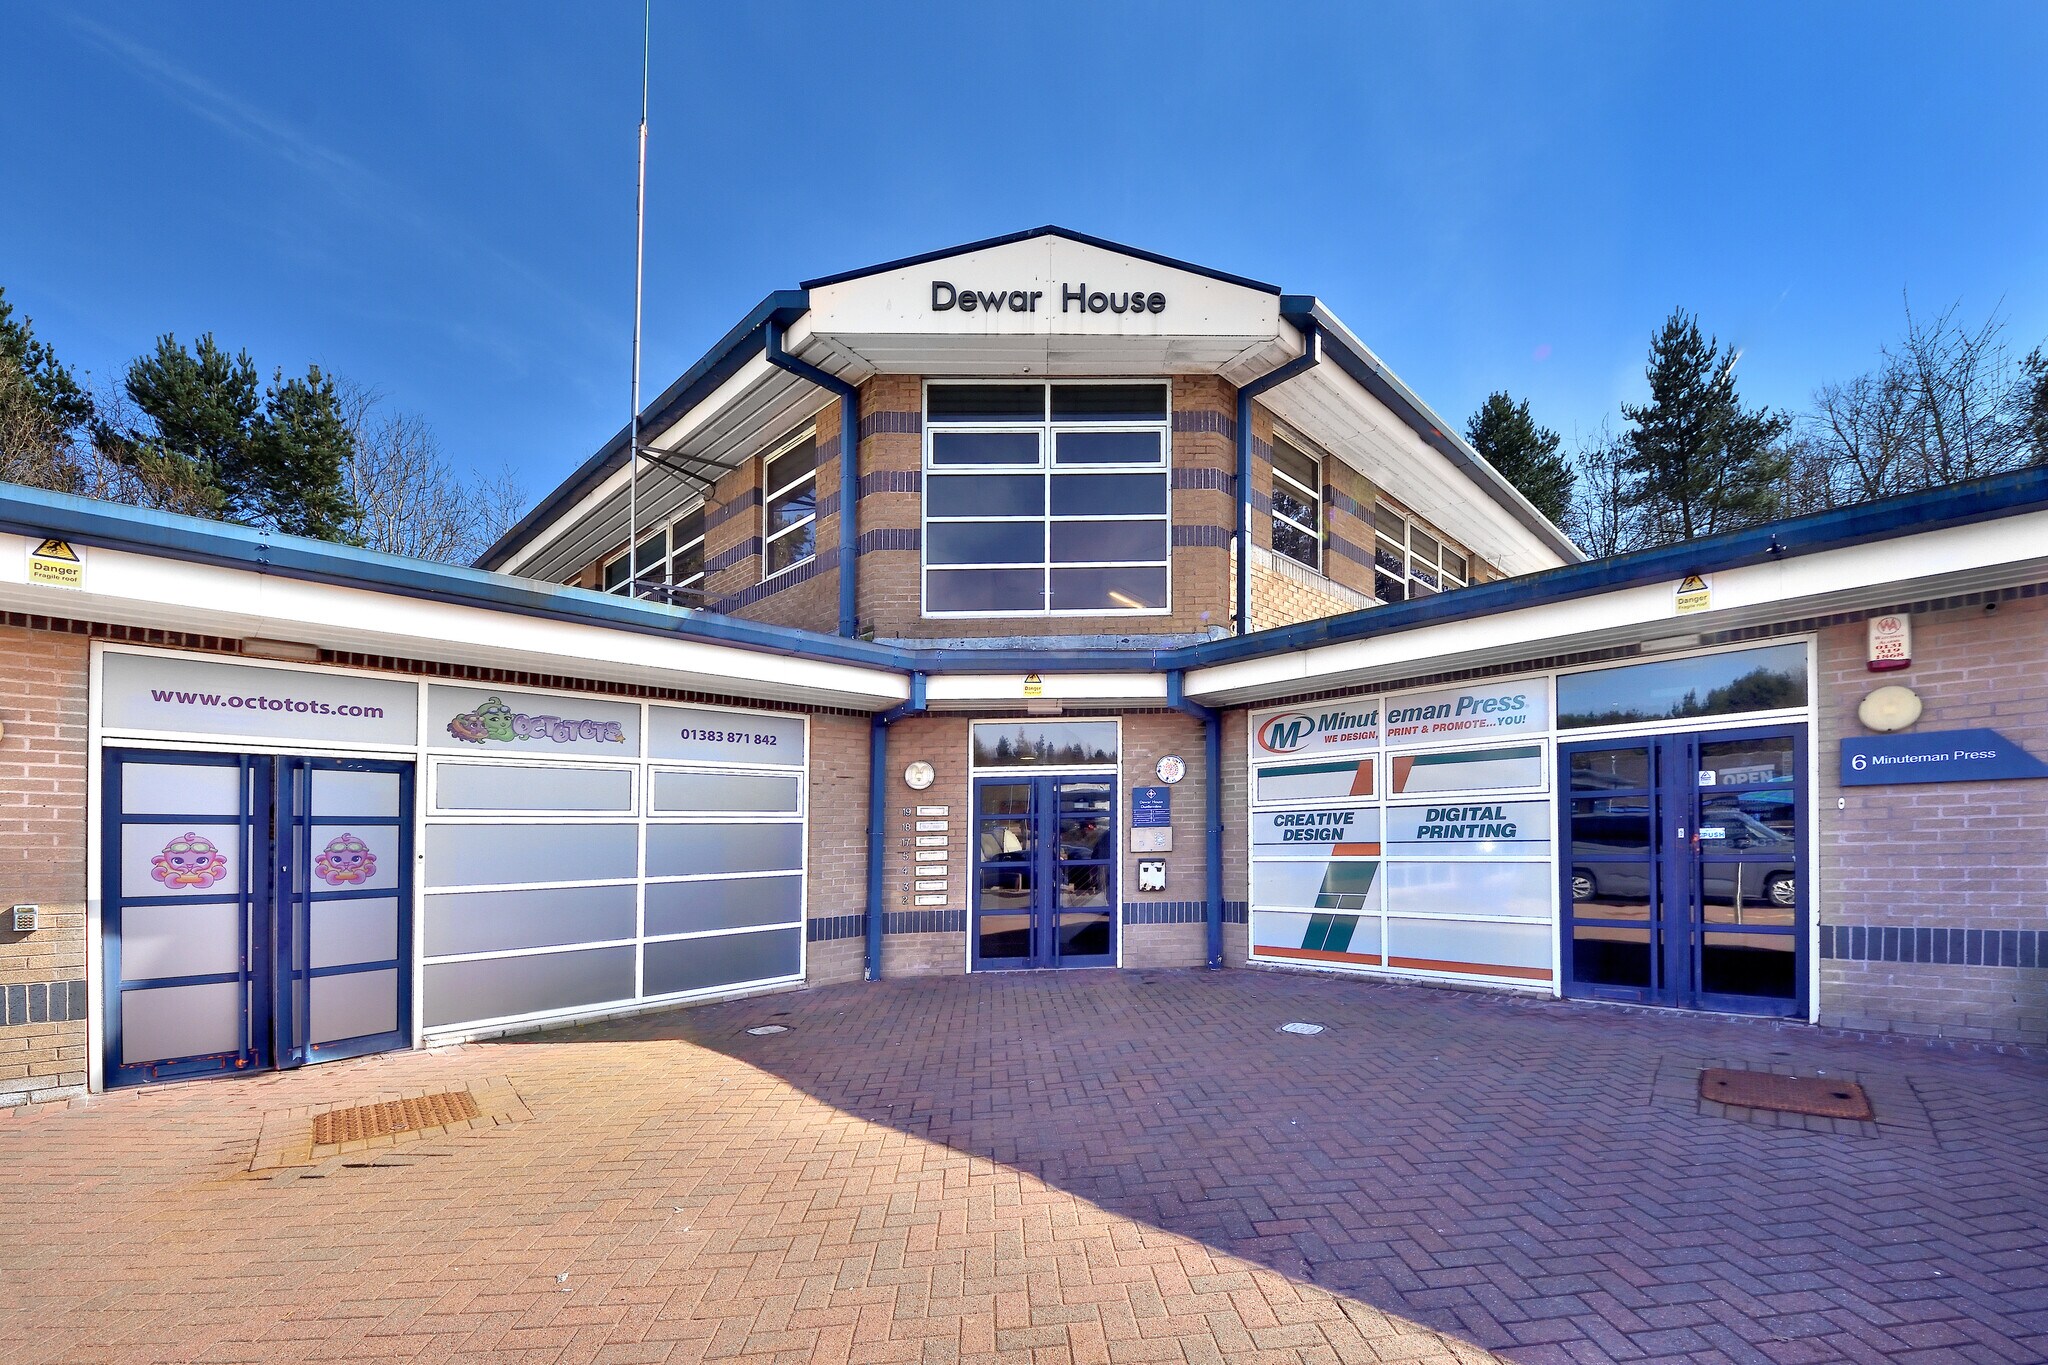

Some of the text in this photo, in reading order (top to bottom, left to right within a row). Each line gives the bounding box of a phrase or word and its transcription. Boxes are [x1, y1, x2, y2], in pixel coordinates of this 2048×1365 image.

[932, 280, 1166, 314] Dewar House
[33, 562, 79, 575] Danger
[33, 572, 60, 580] Fragile
[1678, 595, 1708, 605] Danger
[151, 687, 384, 719] www.octotots.com
[1455, 694, 1526, 717] Press
[680, 728, 777, 746] 01383 871 842
[1324, 734, 1338, 743] WE
[1340, 731, 1379, 742] DESIGN,
[1387, 725, 1419, 737] PRINT
[1421, 724, 1429, 734] &
[1851, 750, 1996, 771] 6 Minuteman Press
[1723, 770, 1773, 785] OPEN
[902, 807, 912, 817] 19
[1273, 811, 1355, 828] CREATIVE
[1425, 806, 1507, 823] DIGITAL
[1283, 828, 1345, 841] DESIGN
[1416, 823, 1517, 839] PRINTING
[902, 881, 909, 891] 3
[902, 895, 908, 905] 2
